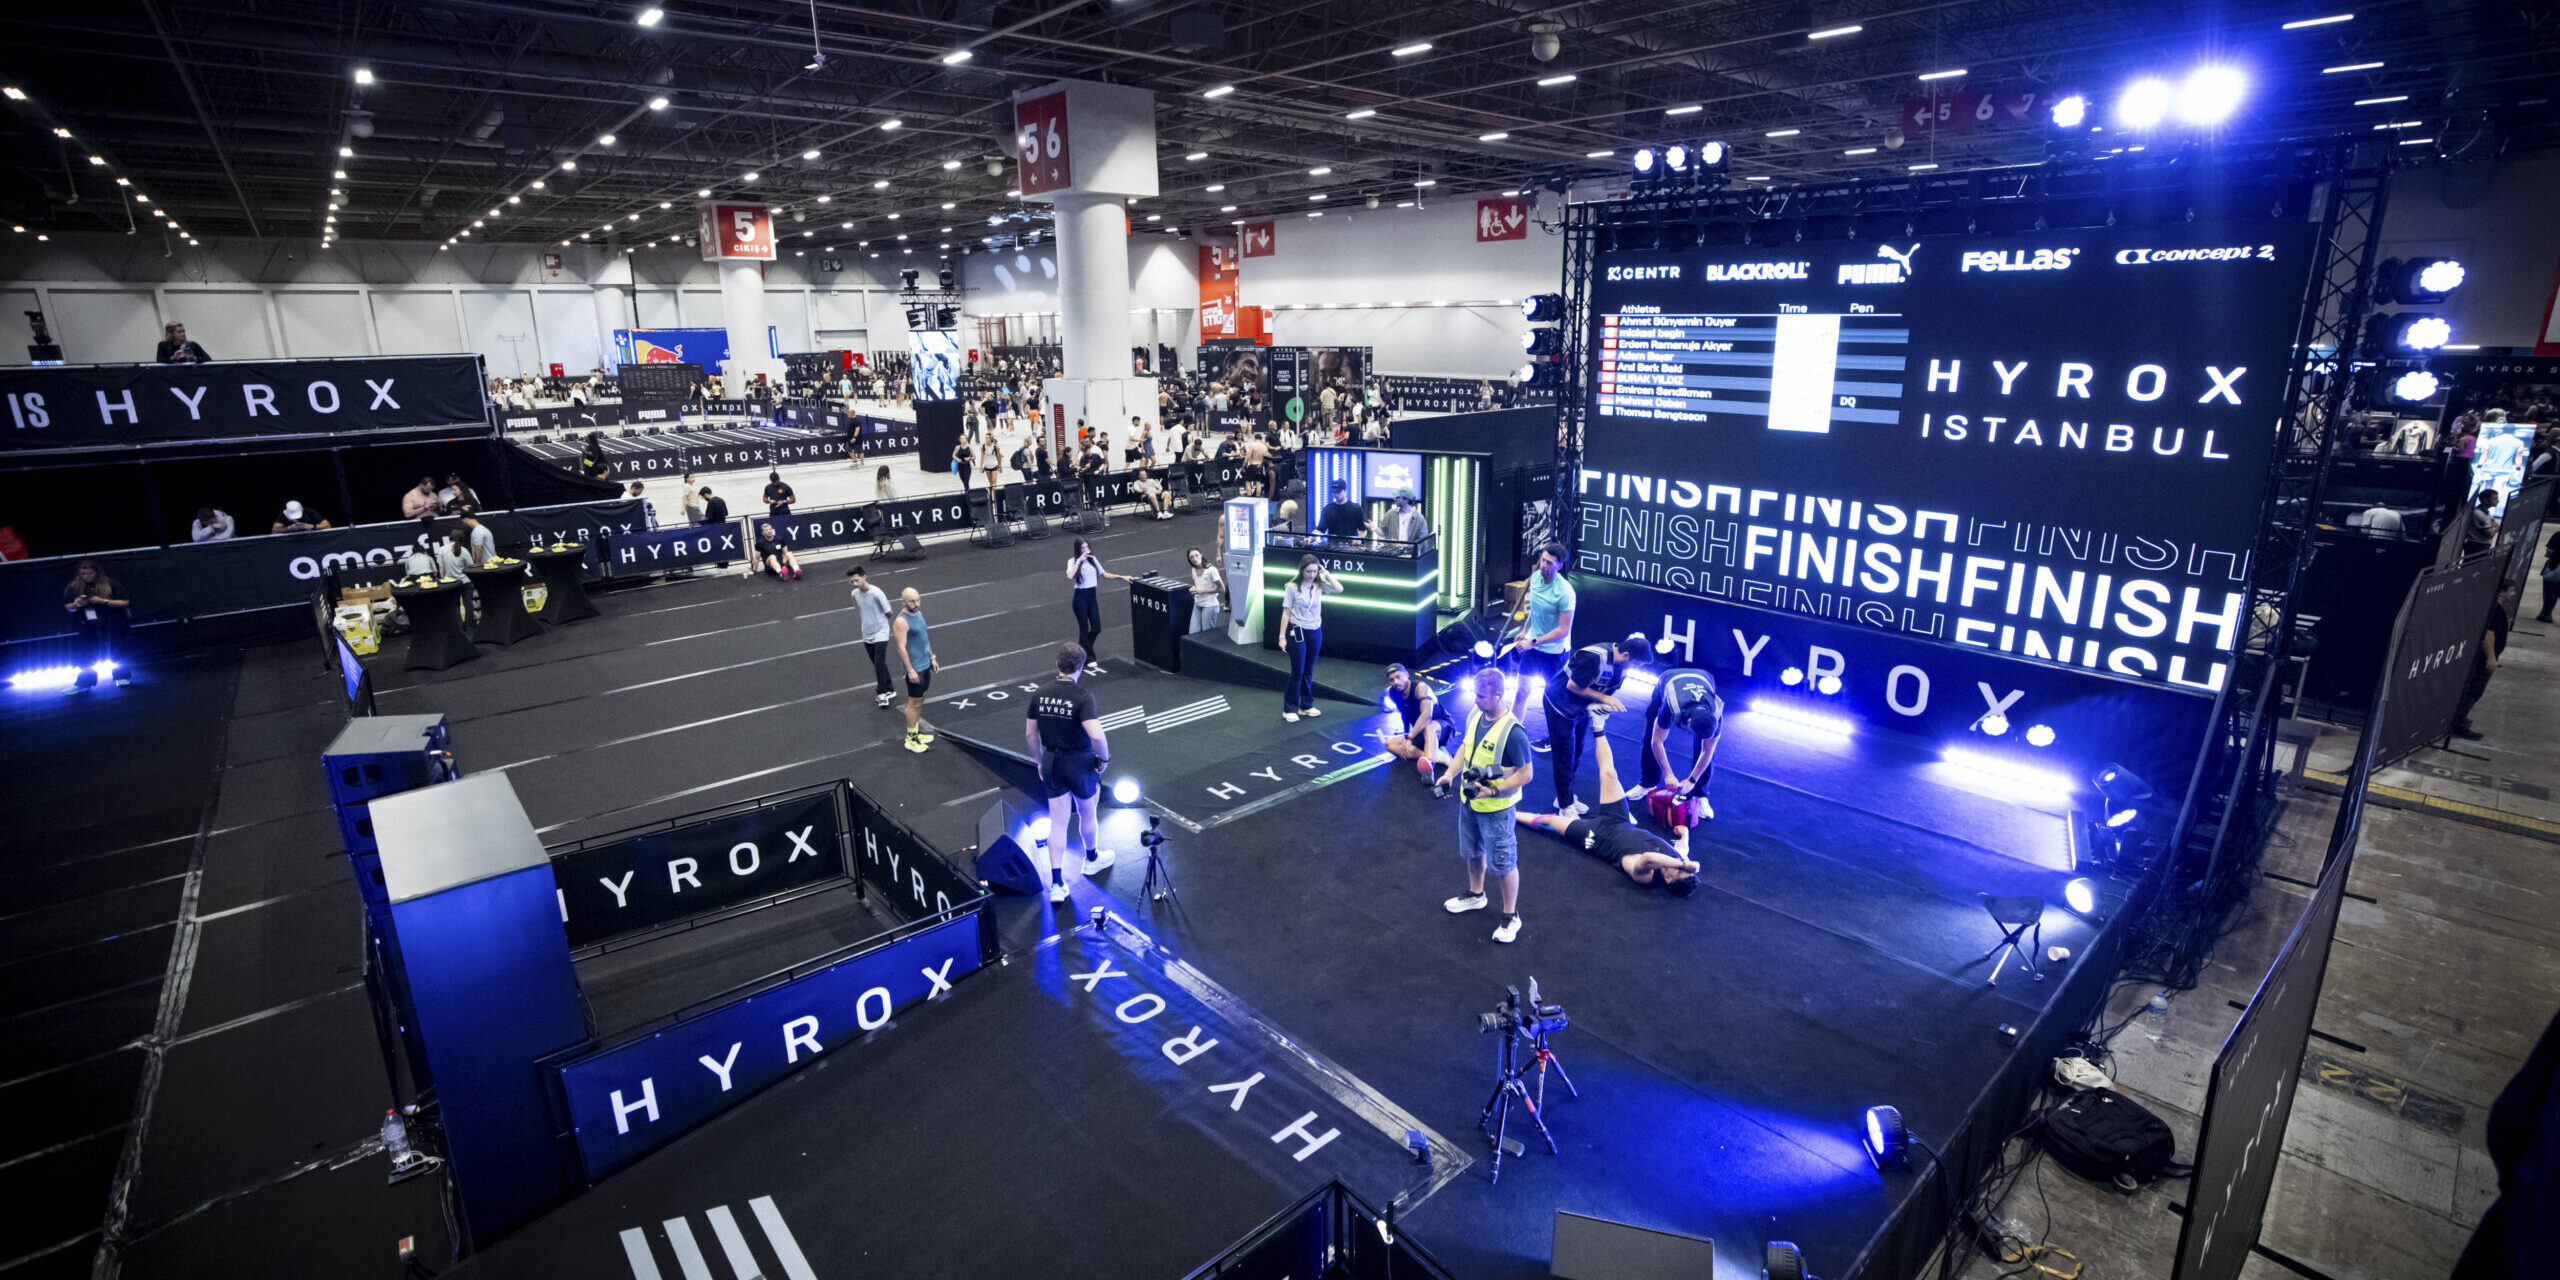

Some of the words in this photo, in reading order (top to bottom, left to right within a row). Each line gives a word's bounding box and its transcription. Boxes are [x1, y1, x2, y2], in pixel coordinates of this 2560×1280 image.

[1938, 103, 1952, 121] 5
[1975, 94, 1995, 121] 6
[2022, 93, 2036, 112] 7
[1024, 122, 1039, 164] 5
[1046, 117, 1061, 159] 6
[733, 210, 756, 243] 5
[1212, 245, 1222, 266] 5
[2151, 245, 2252, 262] concept
[1623, 266, 1681, 280] CENTR
[1838, 263, 1901, 285] PUMA
[1620, 304, 1661, 314] Athletes
[1779, 303, 1808, 314] Time
[1850, 303, 1875, 314] Pen
[2475, 365, 2536, 373] HYROX
[1927, 357, 2248, 405] HYROX
[7, 391, 51, 430] IS
[96, 377, 402, 426] HYROX
[707, 403, 742, 412] HYROX
[1406, 398, 1449, 408] HYROX
[1921, 413, 2231, 460] ISTANBUL
[693, 449, 764, 467] HYROX
[781, 442, 846, 459] HYROX
[613, 457, 674, 474] YROX
[890, 505, 963, 528] HYRO
[770, 517, 866, 542] YROX
[620, 534, 736, 565] HYROX
[1322, 558, 1366, 573] YROX
[1132, 593, 1169, 614] HYROX
[2407, 639, 2467, 680] HYROX
[1663, 613, 2026, 732] HYROX
[949, 660, 1108, 711] HROX
[1038, 705, 1073, 717] HYROX
[863, 825, 952, 921] HYRO
[610, 957, 954, 1135] HYROX
[1069, 958, 1342, 1163] HYROX
